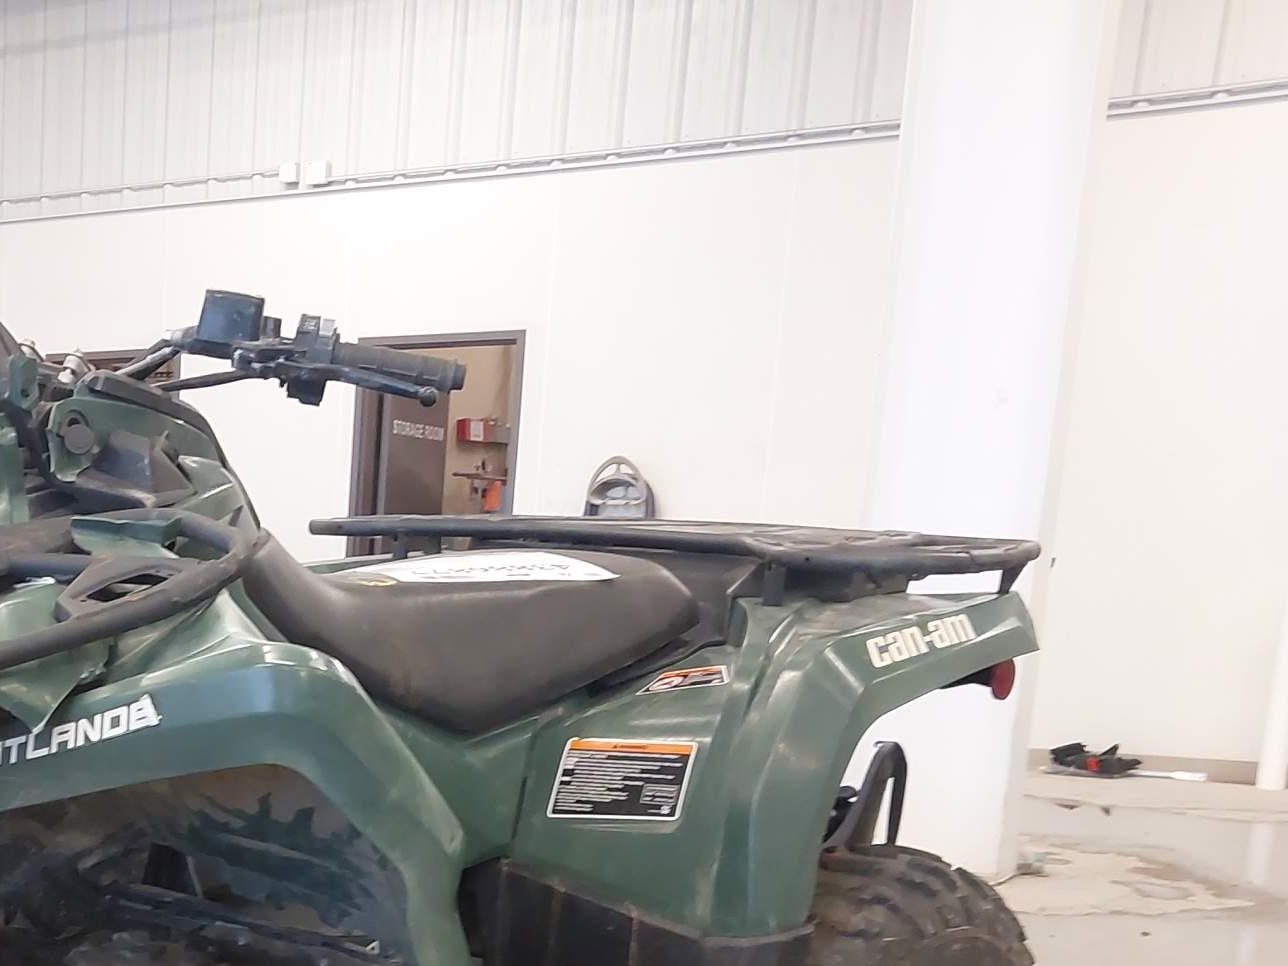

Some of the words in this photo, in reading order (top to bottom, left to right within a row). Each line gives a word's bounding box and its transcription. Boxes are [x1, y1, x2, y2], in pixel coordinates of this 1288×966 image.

[393, 419, 423, 438] STORAGE
[425, 425, 444, 441] ROOM
[865, 613, 977, 668] can-am
